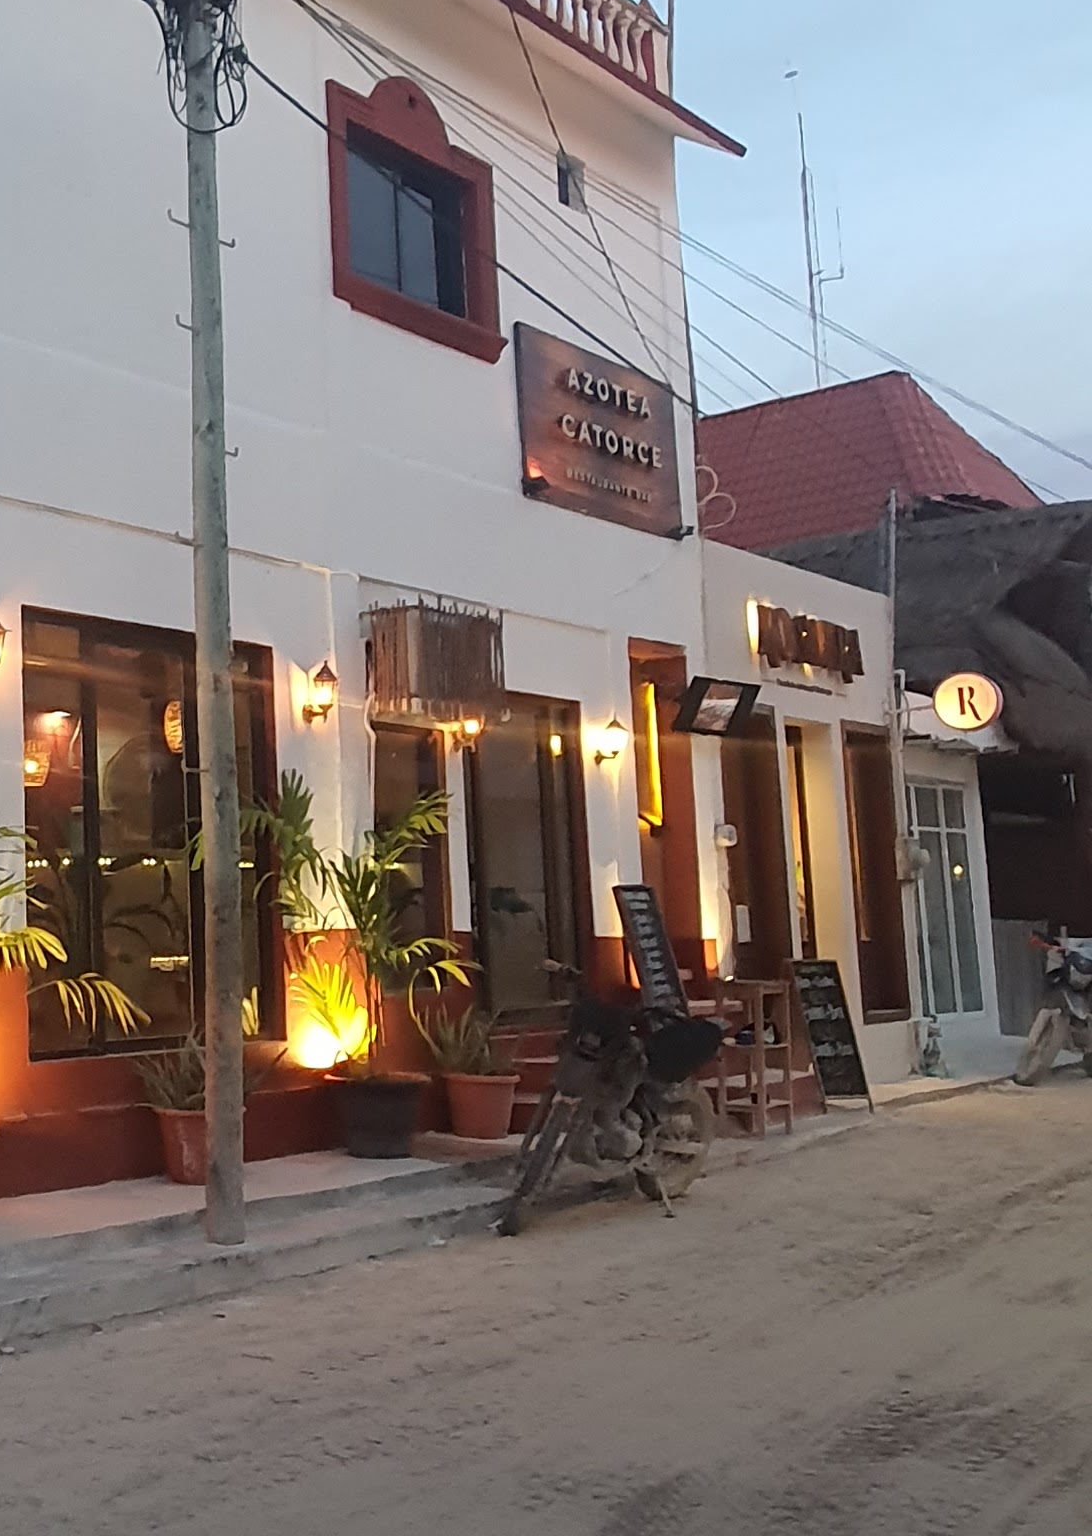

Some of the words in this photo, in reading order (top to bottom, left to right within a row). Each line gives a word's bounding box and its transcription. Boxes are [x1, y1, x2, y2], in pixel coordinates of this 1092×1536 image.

[568, 367, 651, 419] AZOTEA
[561, 413, 663, 469] CATORCE
[957, 685, 981, 721] R
